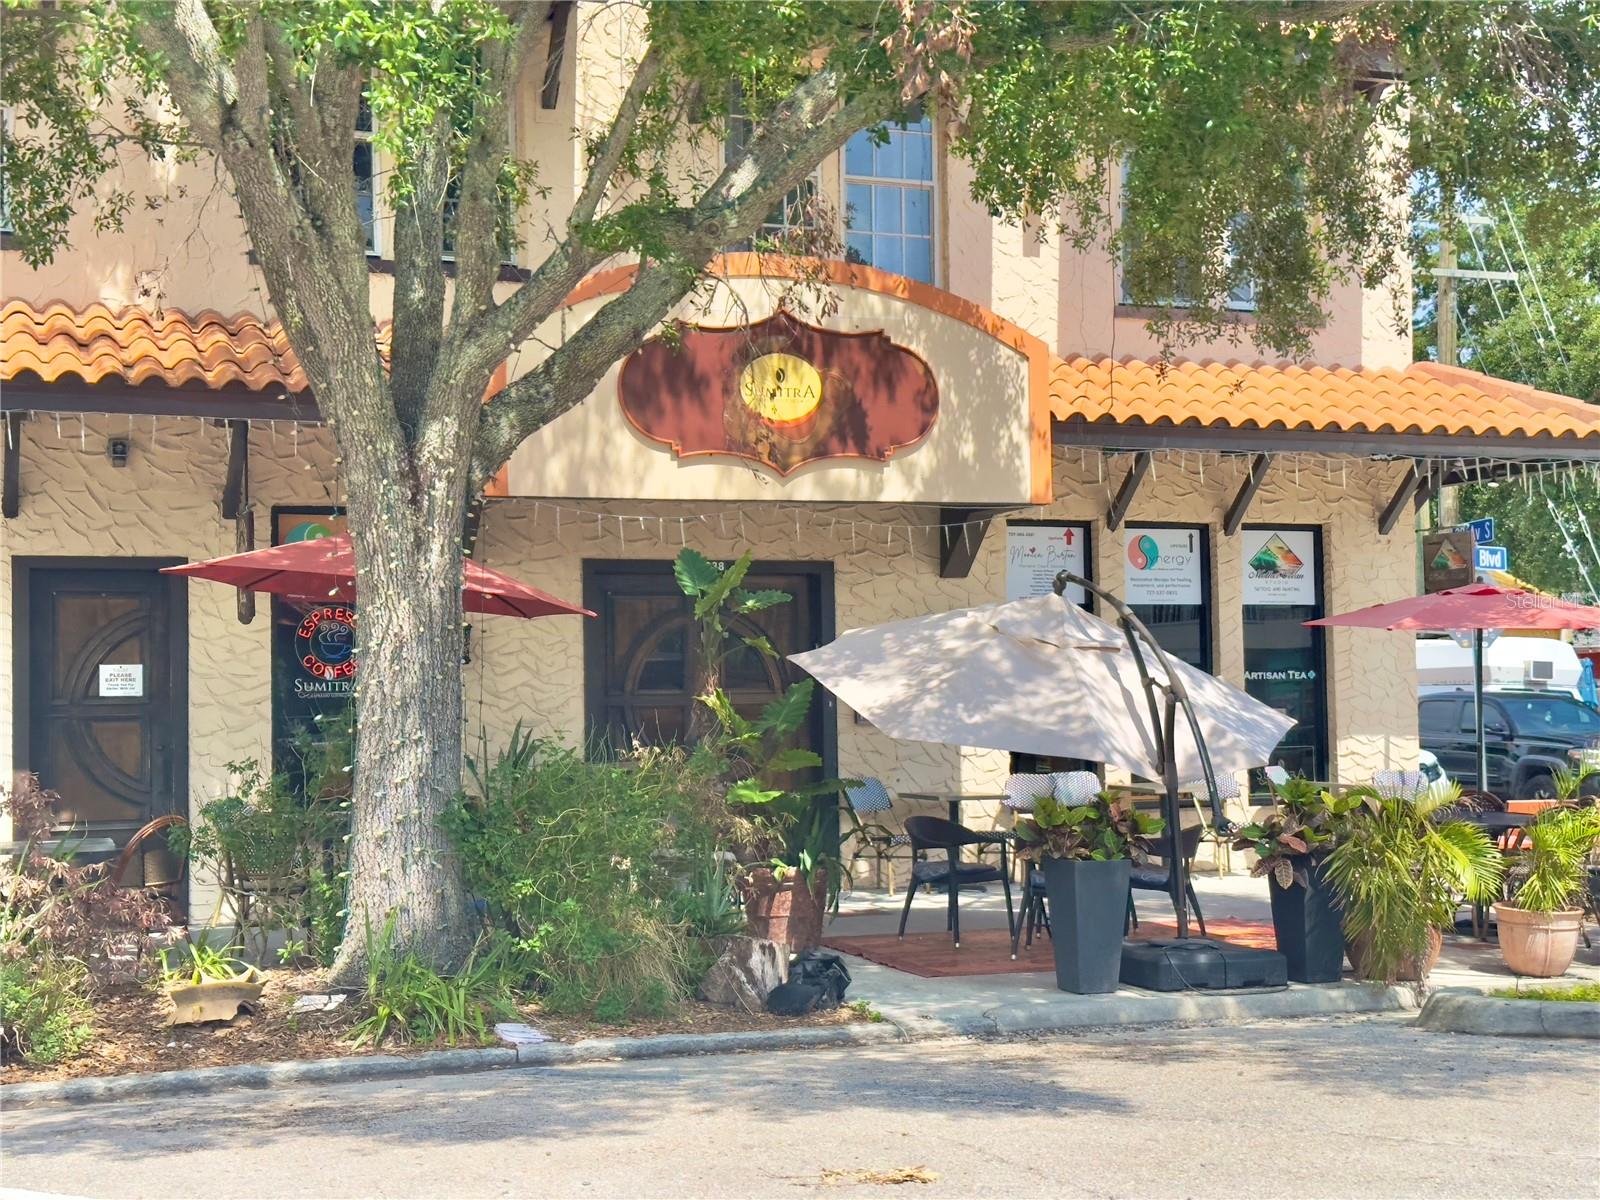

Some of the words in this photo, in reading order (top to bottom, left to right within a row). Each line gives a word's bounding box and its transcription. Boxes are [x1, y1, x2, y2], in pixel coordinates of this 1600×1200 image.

[1485, 521, 1491, 539] S
[1479, 549, 1502, 569] Blvd
[1244, 670, 1286, 680] ARTISAN
[1287, 670, 1307, 680] TEA
